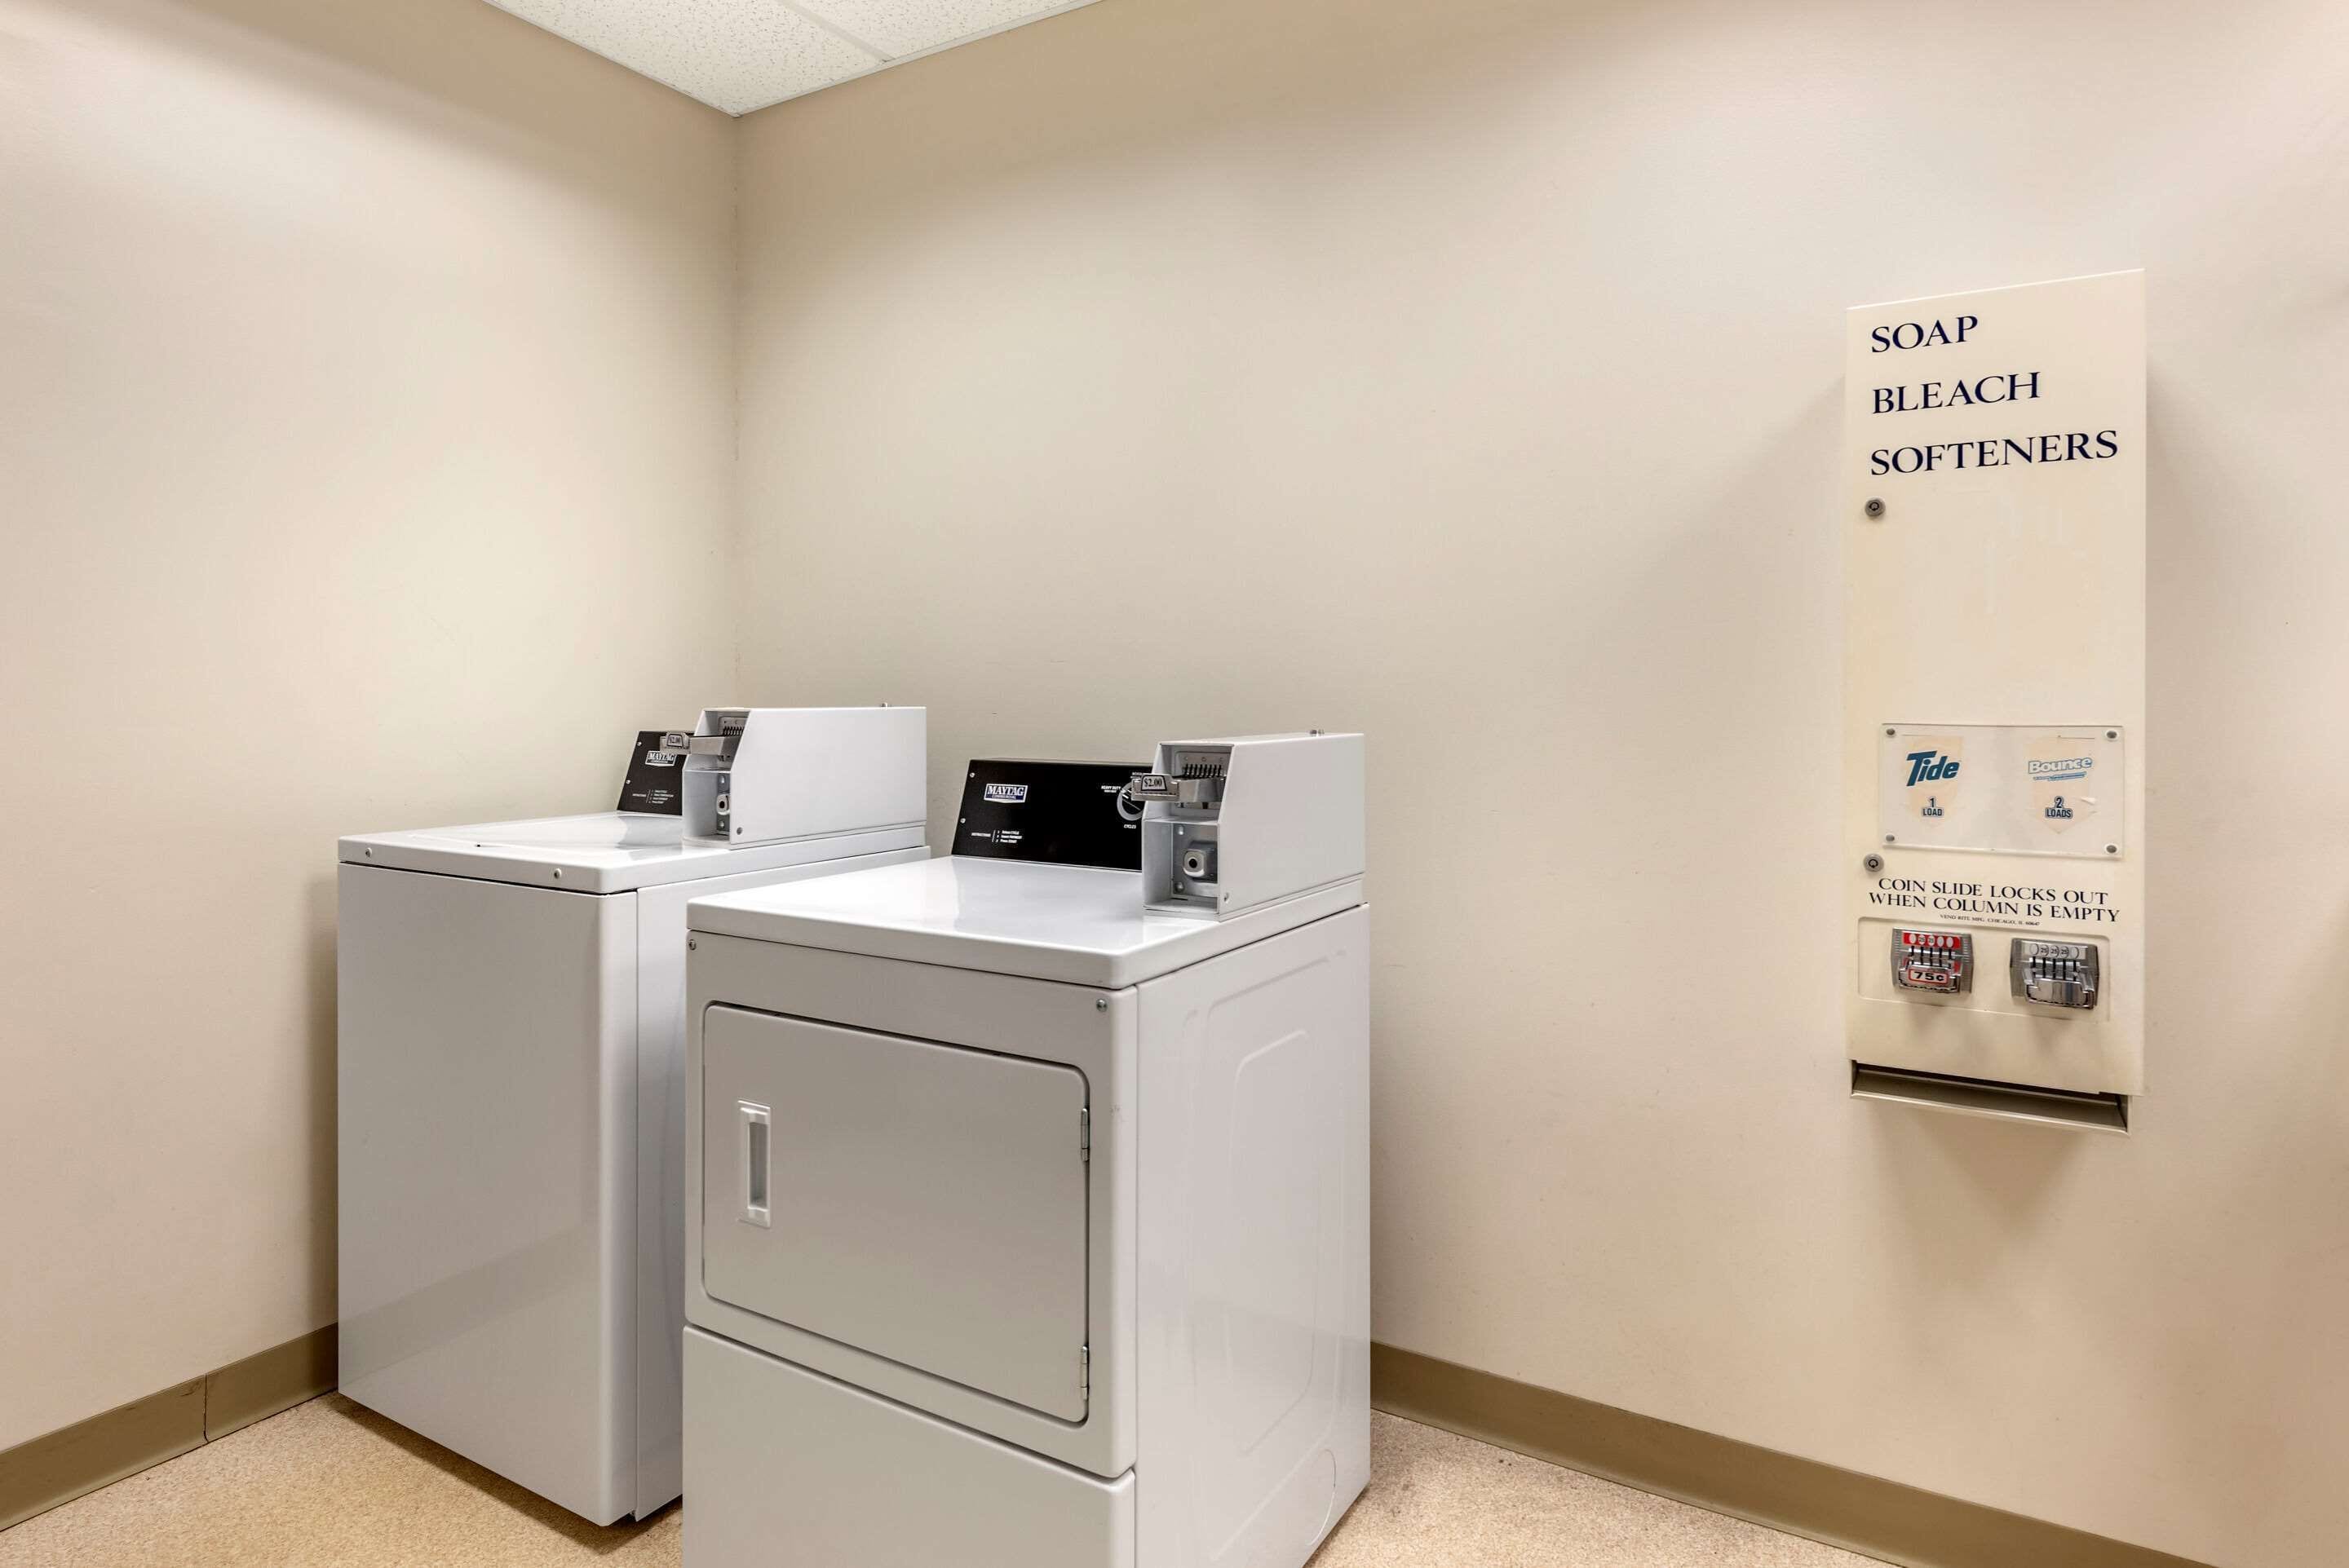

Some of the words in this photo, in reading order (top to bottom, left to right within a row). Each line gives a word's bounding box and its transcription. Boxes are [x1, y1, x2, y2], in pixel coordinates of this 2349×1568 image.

[1871, 315, 1978, 353] SOAP
[1872, 371, 2041, 414] BLEACH
[1870, 430, 2118, 475] SOFTENERS
[648, 752, 675, 762] MAYTAG
[1905, 750, 1961, 787] Tide
[2028, 757, 2093, 774] Bounce
[1144, 777, 1163, 788] $2.00
[987, 785, 1024, 797] MAYTAG
[1929, 797, 1935, 808] 1
[2055, 797, 2063, 809] 2
[1922, 808, 1943, 816] LOAD
[2046, 808, 2073, 819] LOADS
[1878, 877, 1927, 892] COIN
[1931, 881, 1983, 897] SLIDE
[1990, 885, 2056, 902] LOCKS
[2063, 890, 2108, 905] OUT
[1869, 892, 1927, 908] WHEN
[1933, 897, 2019, 915] COLUMN
[2026, 903, 2043, 917] IS
[2050, 905, 2120, 923] EMPTY
